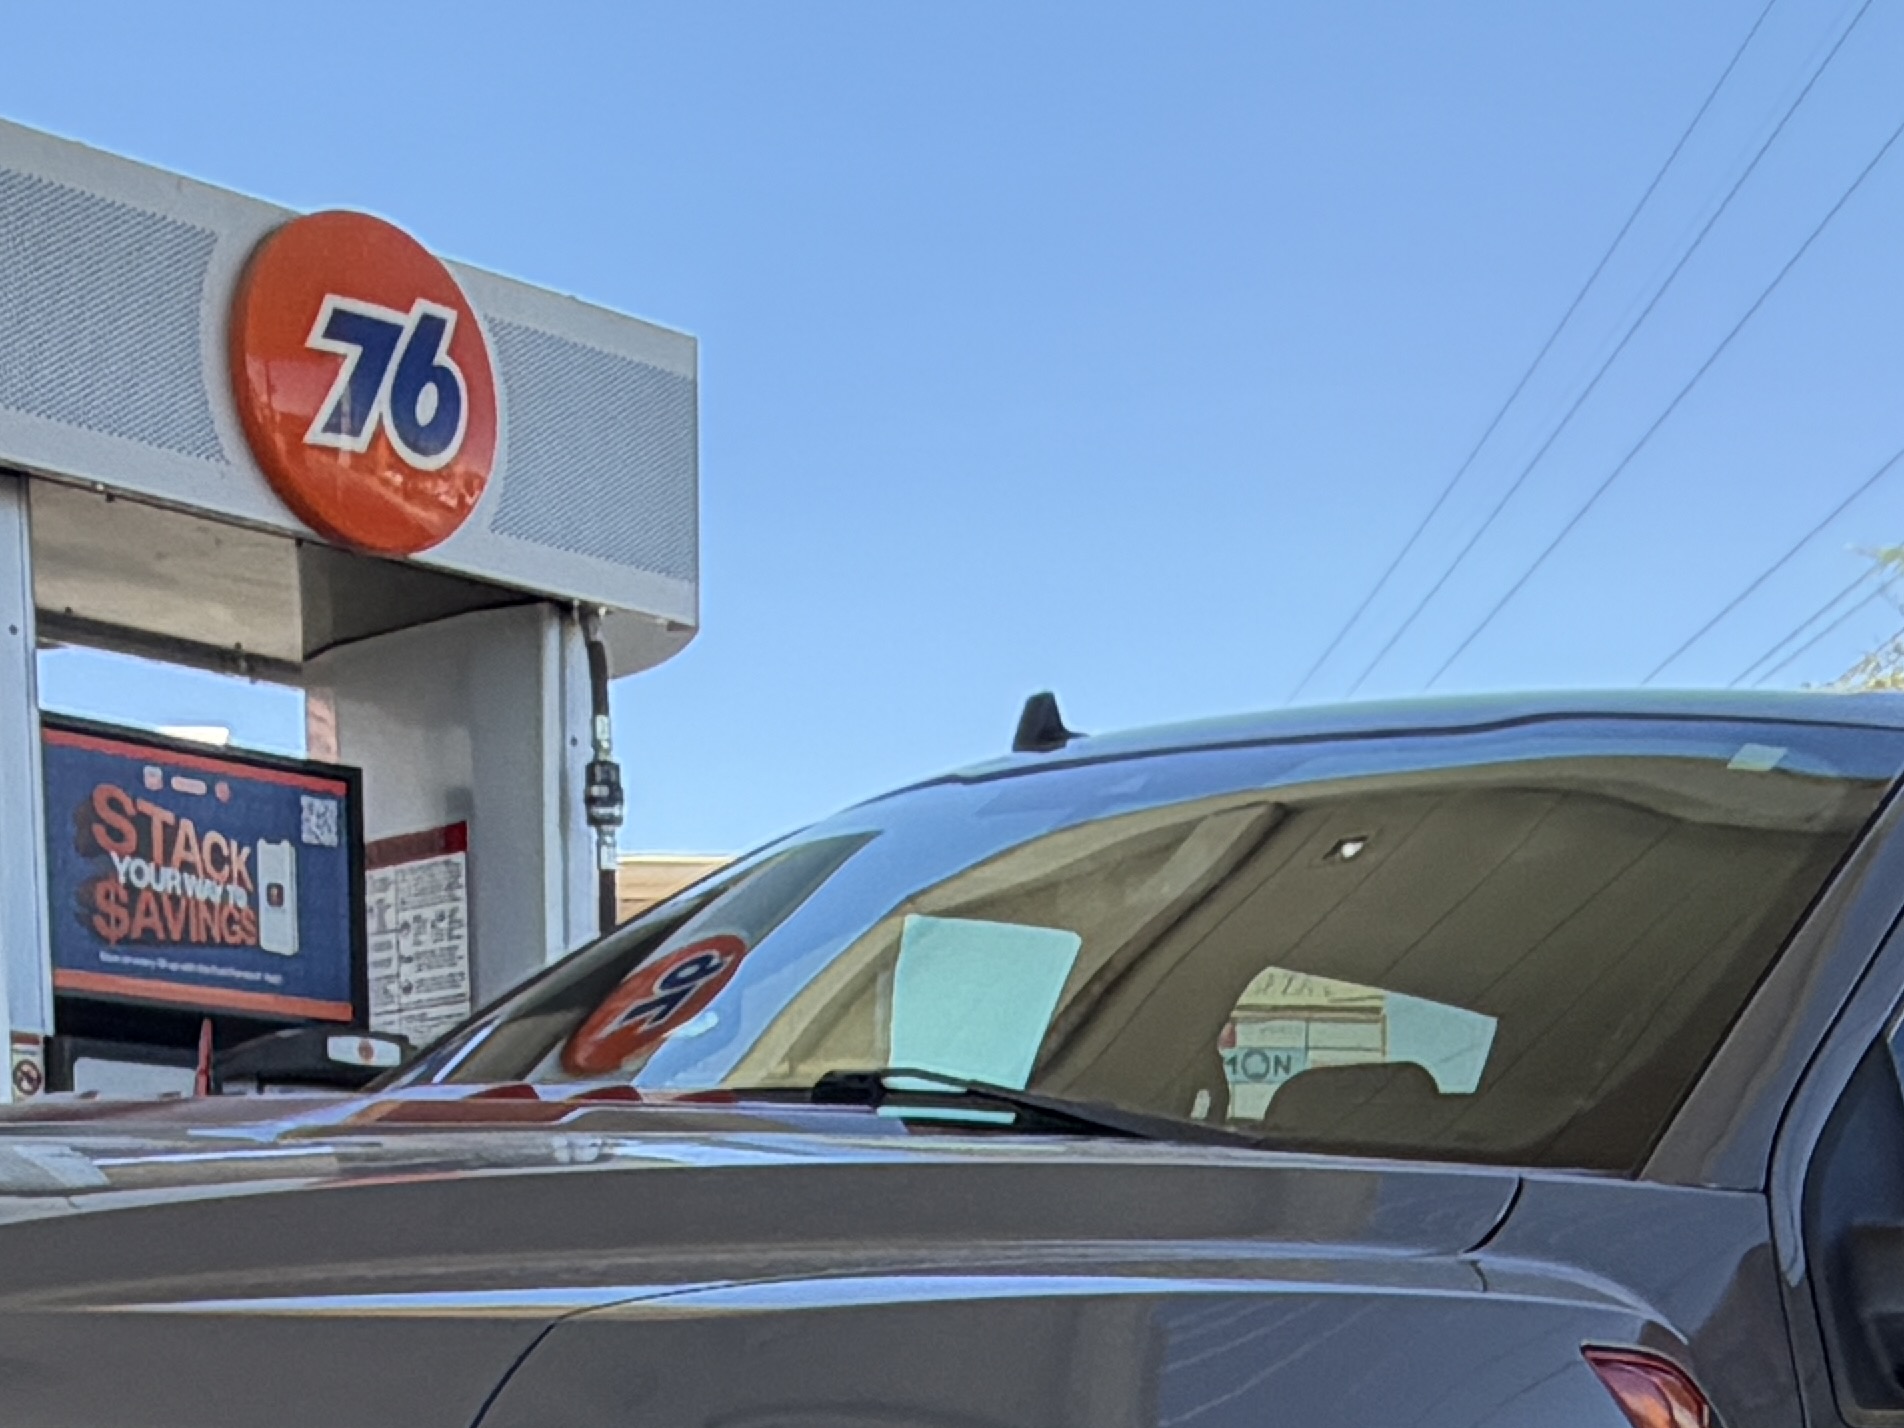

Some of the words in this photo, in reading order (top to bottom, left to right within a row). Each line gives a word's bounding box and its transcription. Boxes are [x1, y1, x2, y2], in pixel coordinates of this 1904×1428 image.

[304, 294, 468, 471] 76
[92, 783, 254, 893] STACK
[110, 851, 183, 897] YOUR
[181, 872, 224, 907] WAY
[92, 878, 258, 946] $AVINGS
